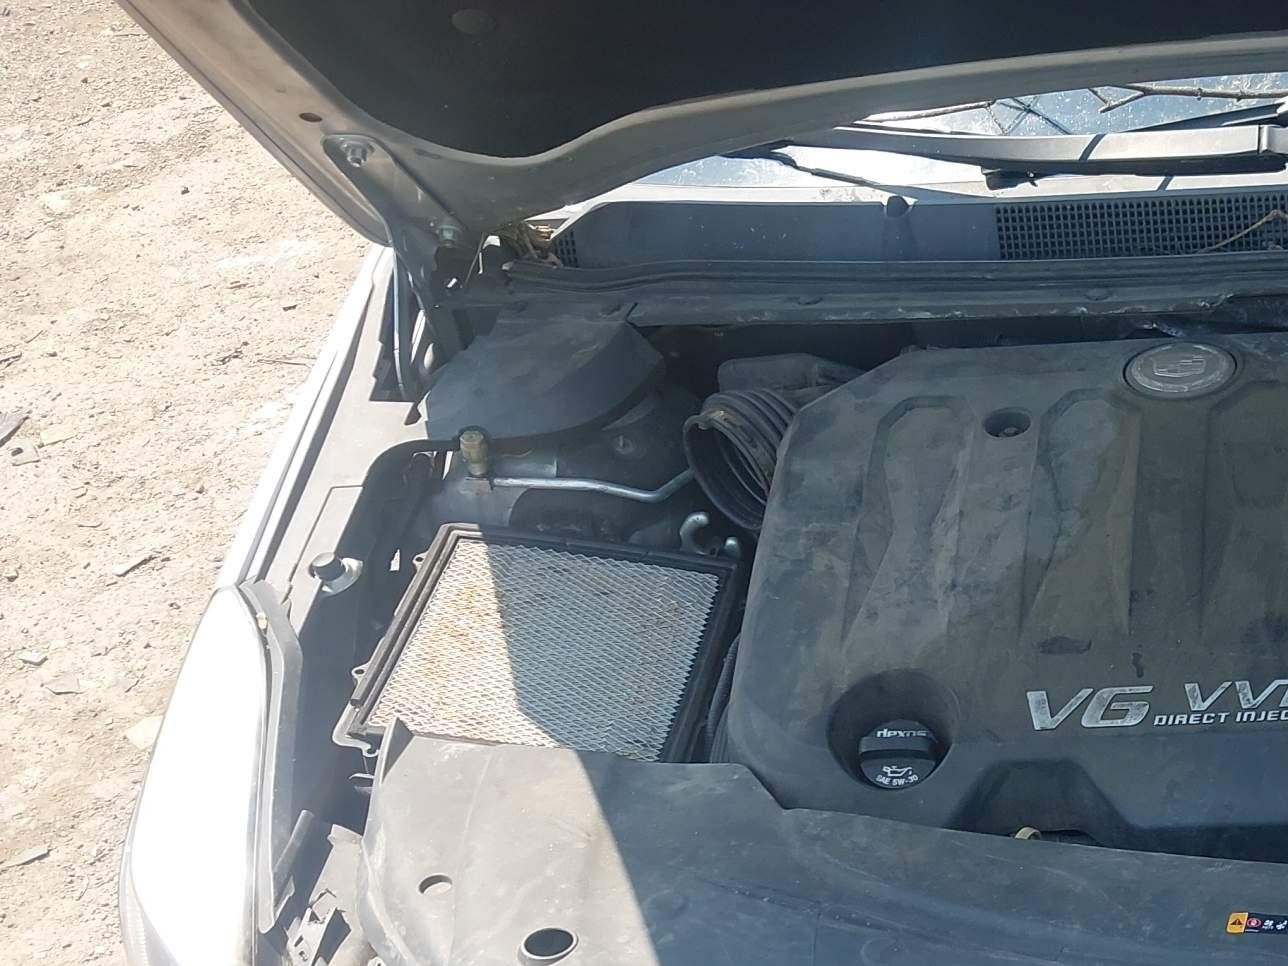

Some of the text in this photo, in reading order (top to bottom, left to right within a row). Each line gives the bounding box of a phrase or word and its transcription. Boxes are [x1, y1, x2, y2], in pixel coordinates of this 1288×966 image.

[1026, 686, 1154, 731] V6
[1153, 711, 1229, 727] DIRECT
[875, 774, 919, 786] SAE 5W-30
